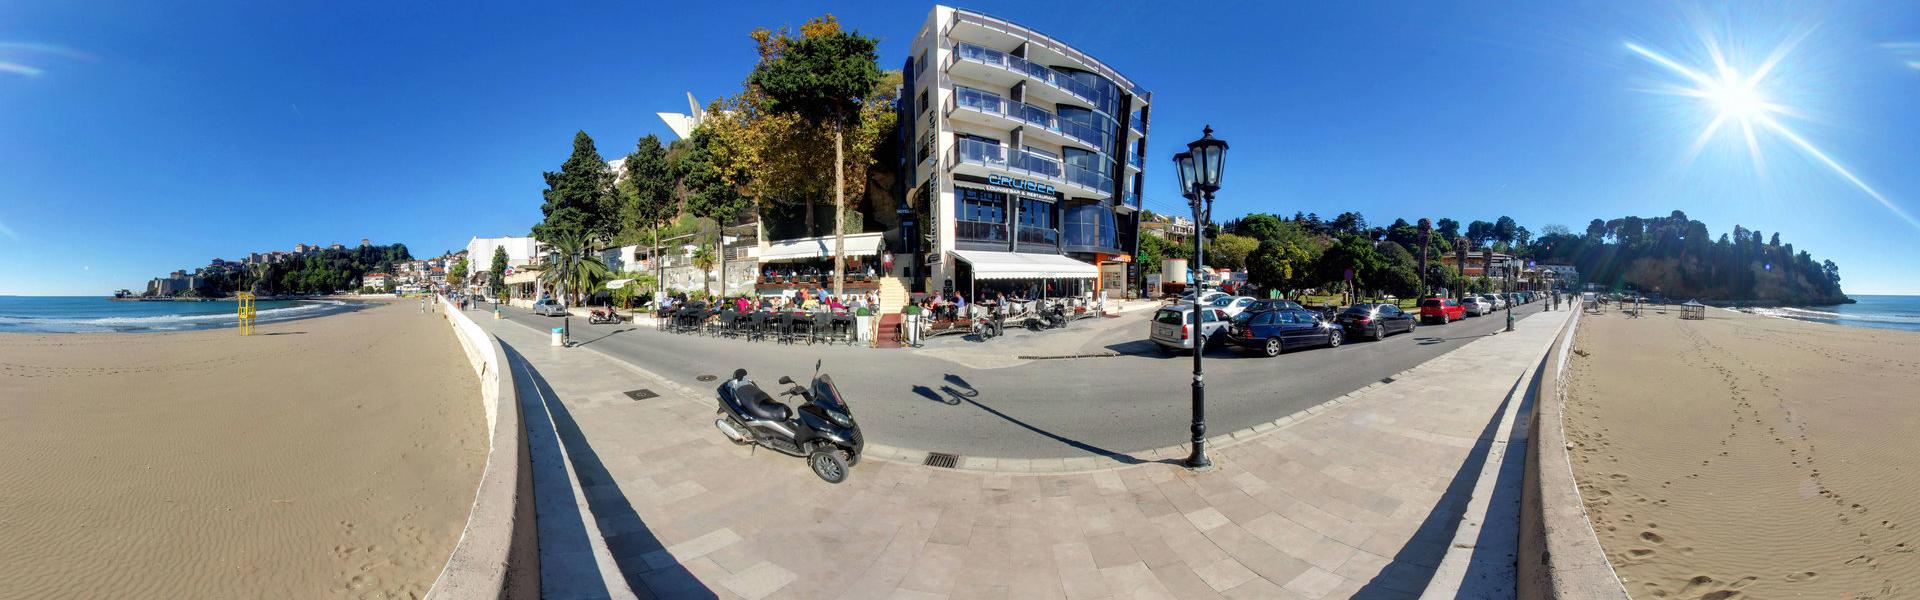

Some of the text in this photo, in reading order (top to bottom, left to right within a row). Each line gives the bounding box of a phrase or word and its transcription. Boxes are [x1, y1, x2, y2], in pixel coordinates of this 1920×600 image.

[986, 185, 1009, 193] LOUNGE
[1026, 191, 1058, 202] RESTAURANT
[988, 173, 1056, 195] CRUISER
